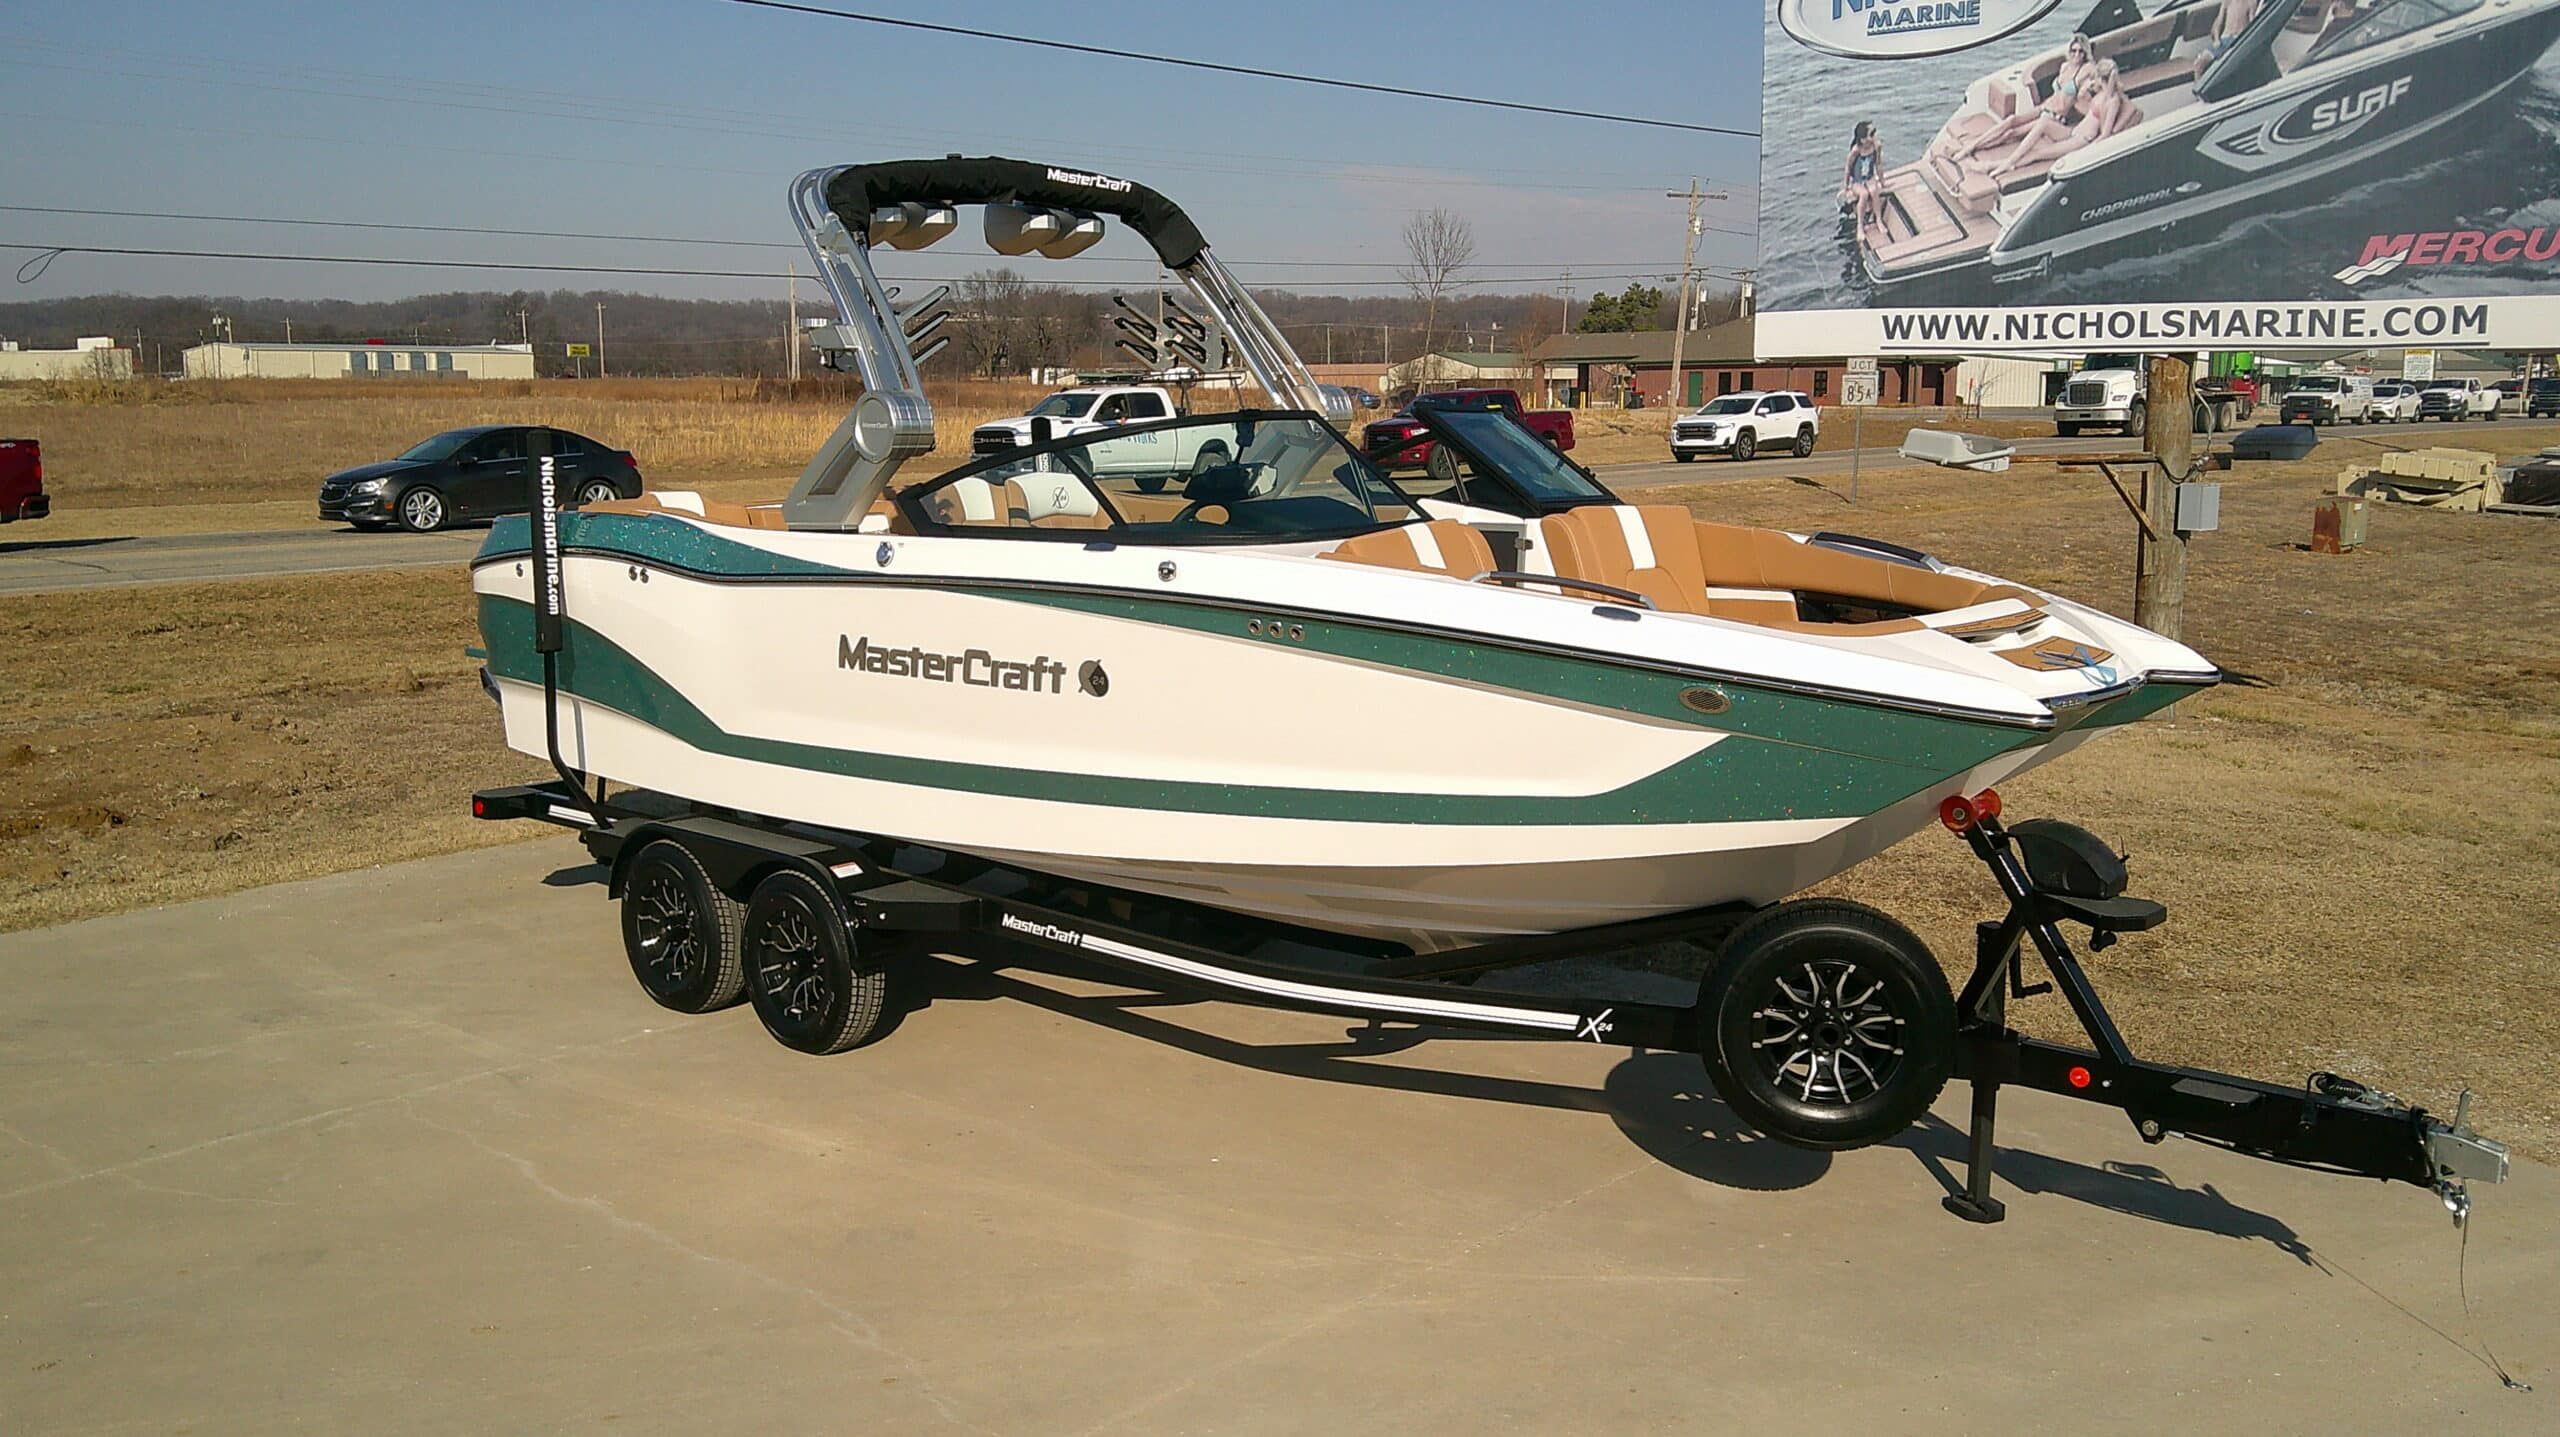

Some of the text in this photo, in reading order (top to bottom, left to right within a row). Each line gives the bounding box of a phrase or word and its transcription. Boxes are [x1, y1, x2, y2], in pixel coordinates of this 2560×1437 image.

[1867, 0, 1980, 28] MARINE
[2311, 75, 2413, 130] SURF
[1046, 167, 1132, 193] MasterCraft
[1881, 304, 2488, 341] WWW.NICHOLSMARINE.COM
[1851, 360, 1873, 370] JCT
[838, 634, 1067, 694] MasterCraft
[1002, 912, 1080, 946] MasterCraft
